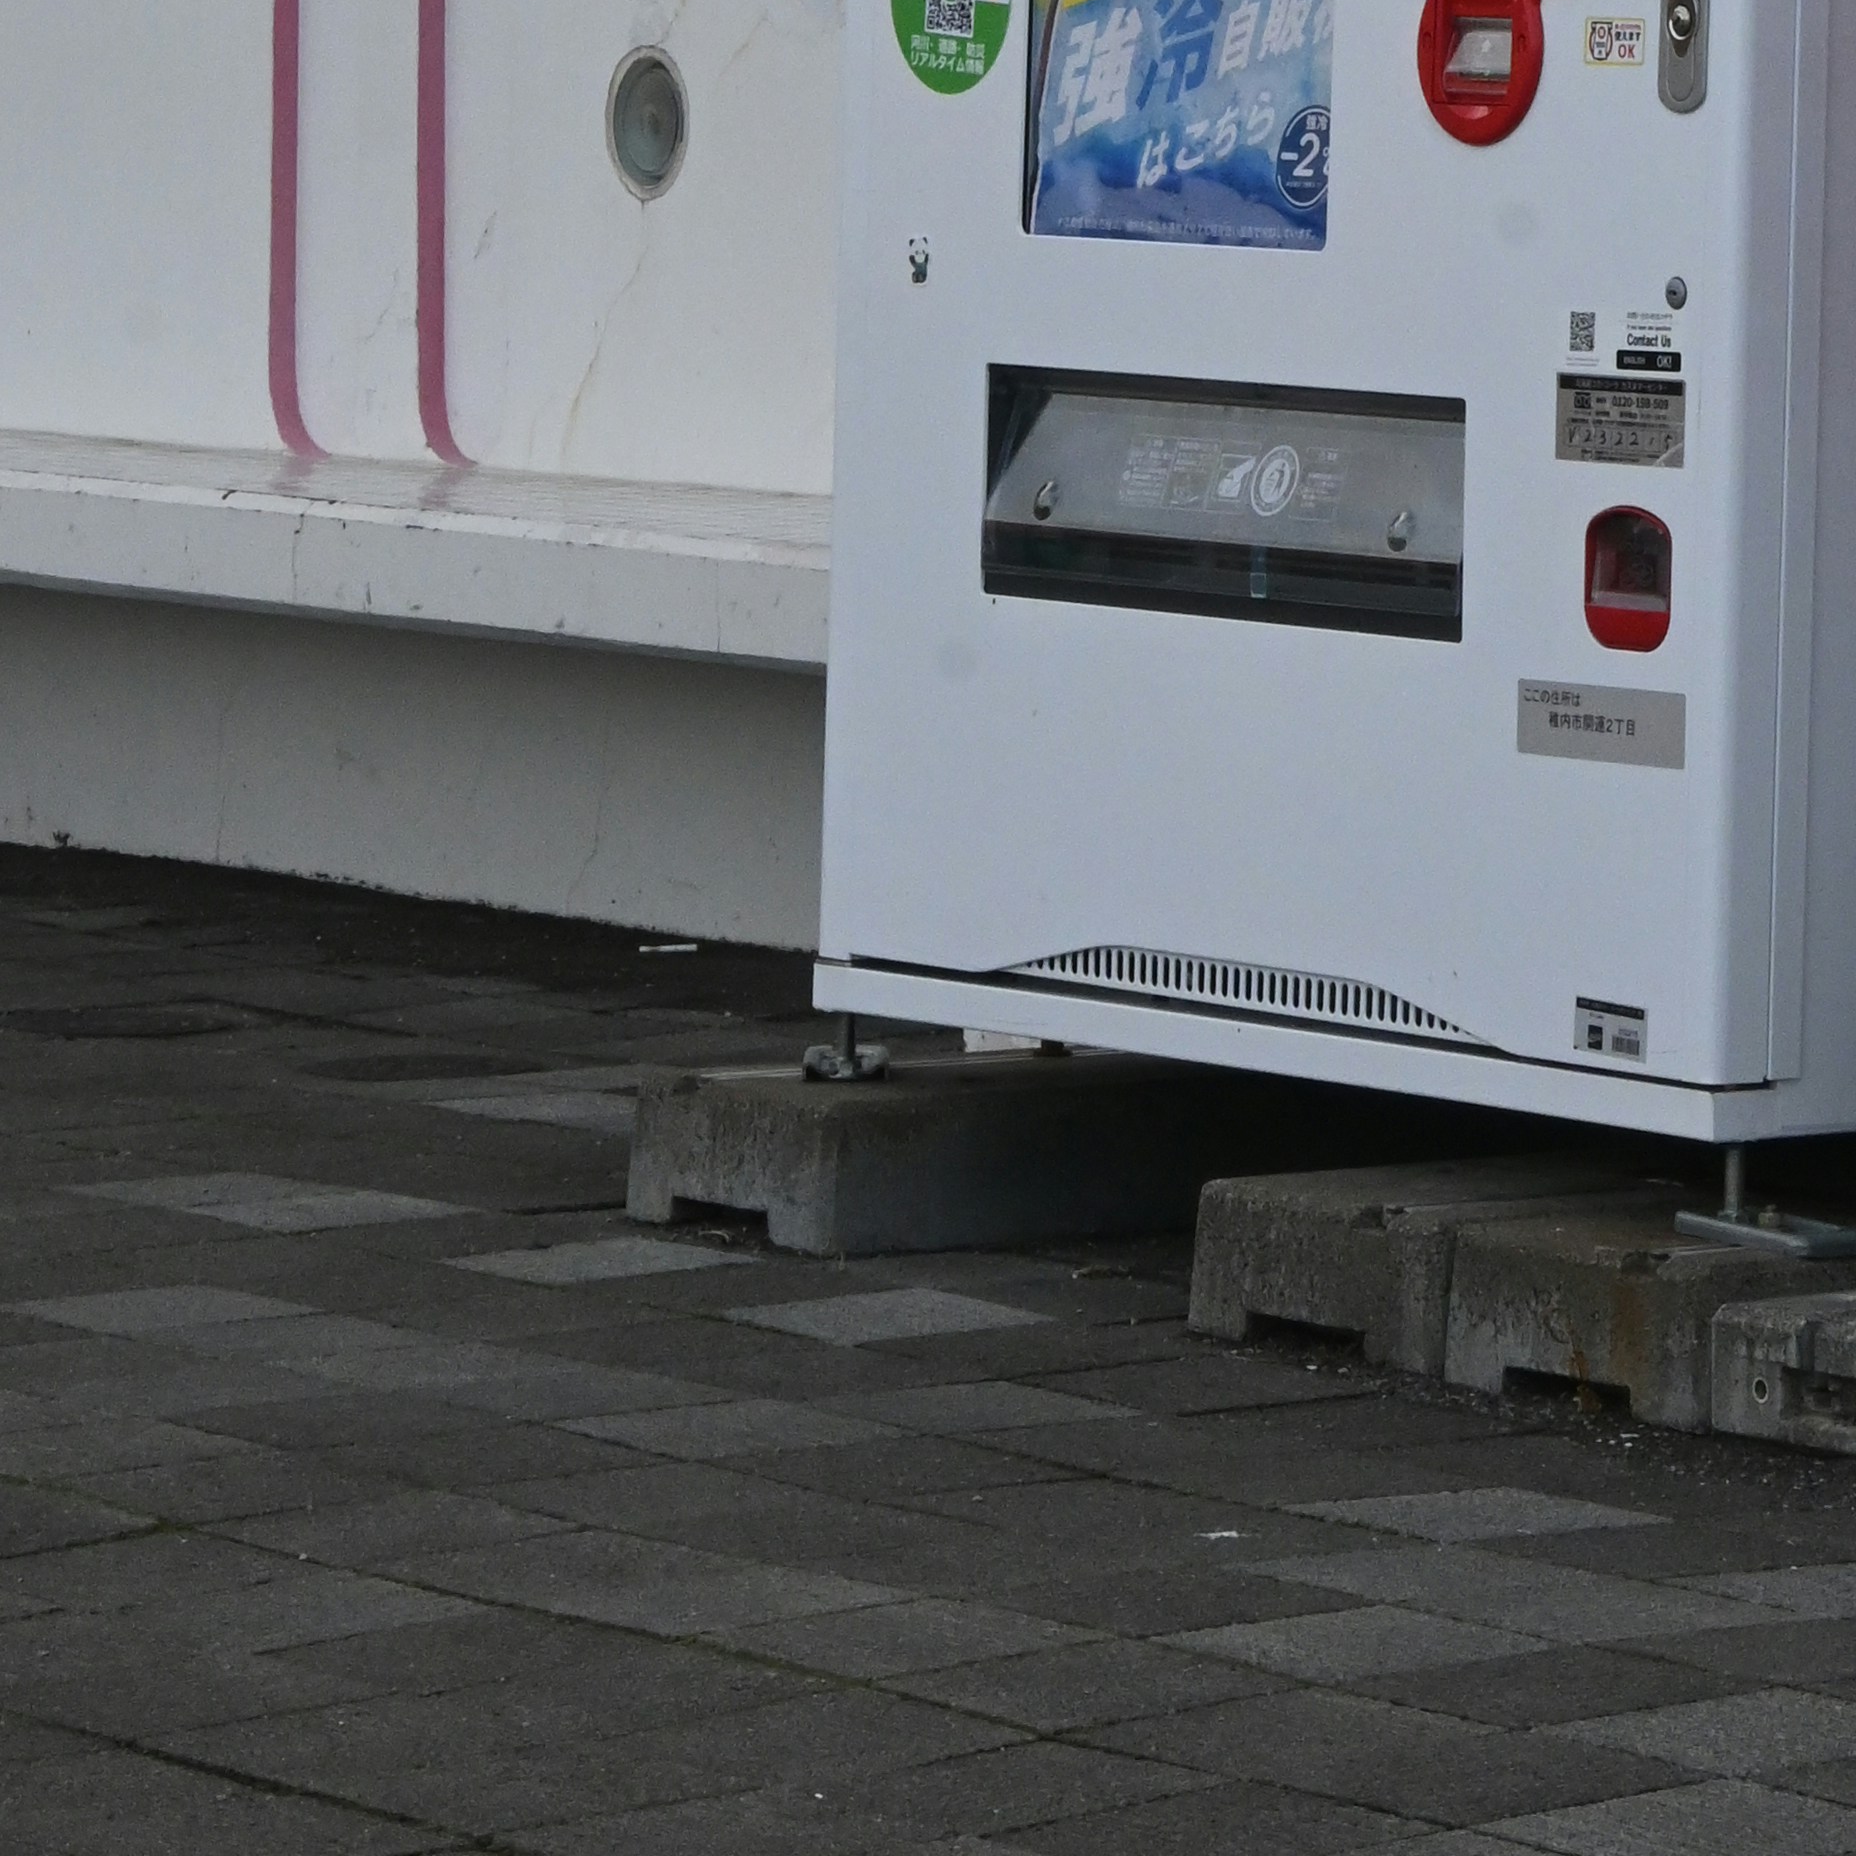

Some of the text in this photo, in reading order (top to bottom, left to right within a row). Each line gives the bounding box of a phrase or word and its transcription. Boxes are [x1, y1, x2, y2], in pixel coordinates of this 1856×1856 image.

[1618, 44, 1636, 59] OK
[1137, 91, 1276, 189] はこちら
[1627, 333, 1672, 348] Contact Us
[1523, 688, 1581, 707] ここの住所は
